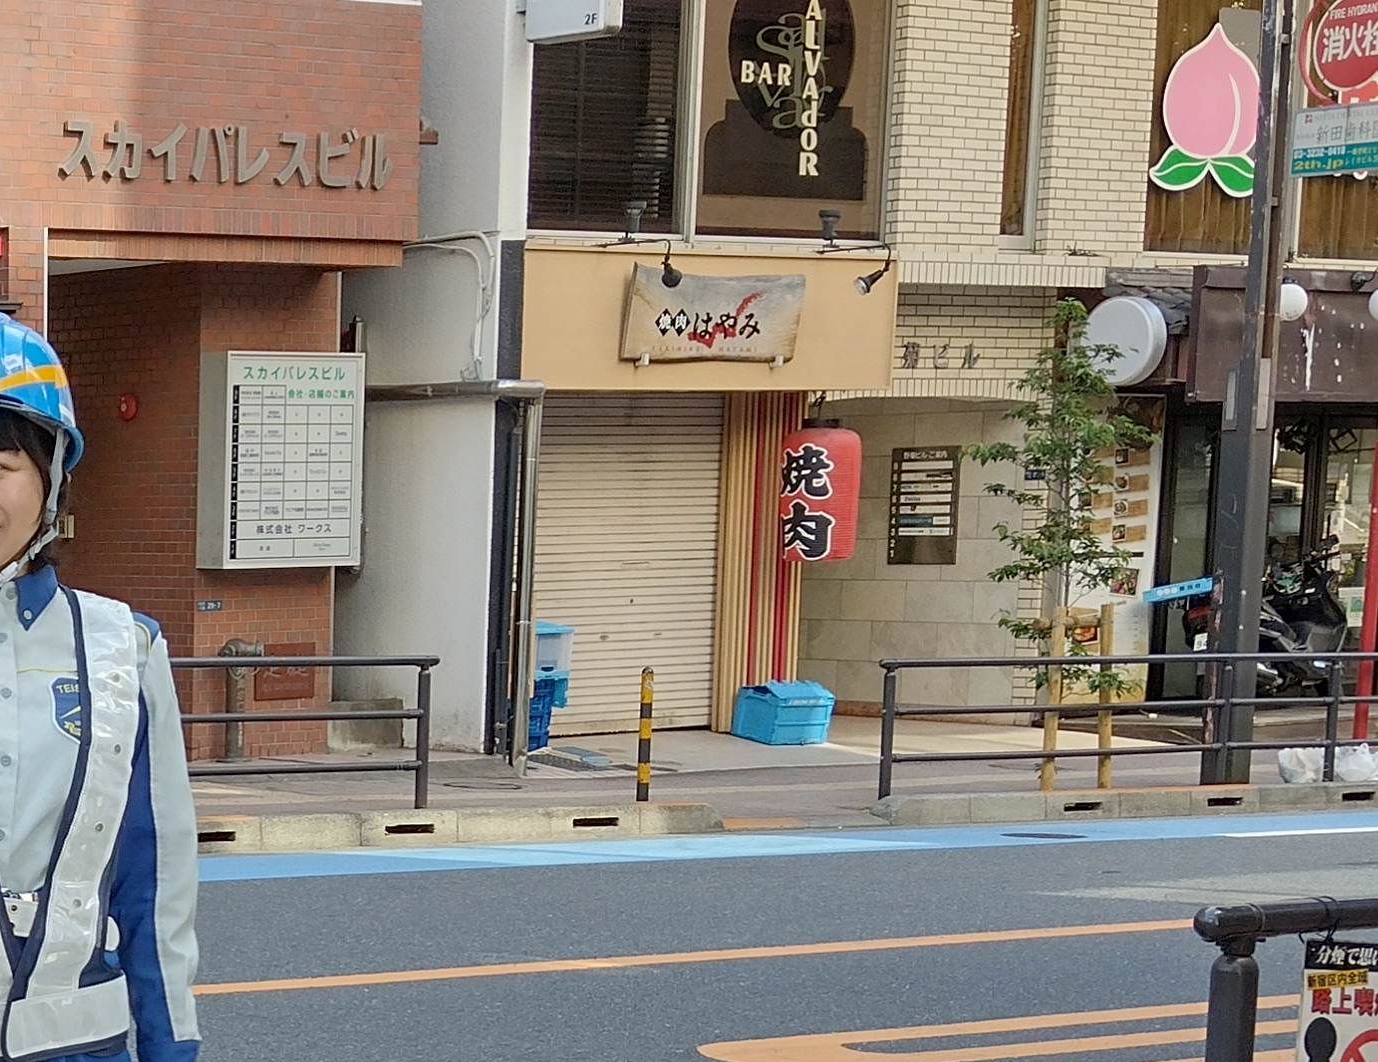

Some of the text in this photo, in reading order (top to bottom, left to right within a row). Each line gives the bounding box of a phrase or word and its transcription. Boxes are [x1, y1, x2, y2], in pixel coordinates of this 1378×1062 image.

[585, 13, 597, 25] 2F
[1330, 8, 1346, 20] FIRE
[740, 59, 791, 86] BAR
[58, 119, 393, 190] スカイパレスビル
[693, 312, 761, 339] はやみ
[780, 443, 835, 562] 焼肉
[297, 523, 332, 533] ワークス
[1311, 986, 1378, 1017] 路上喫
